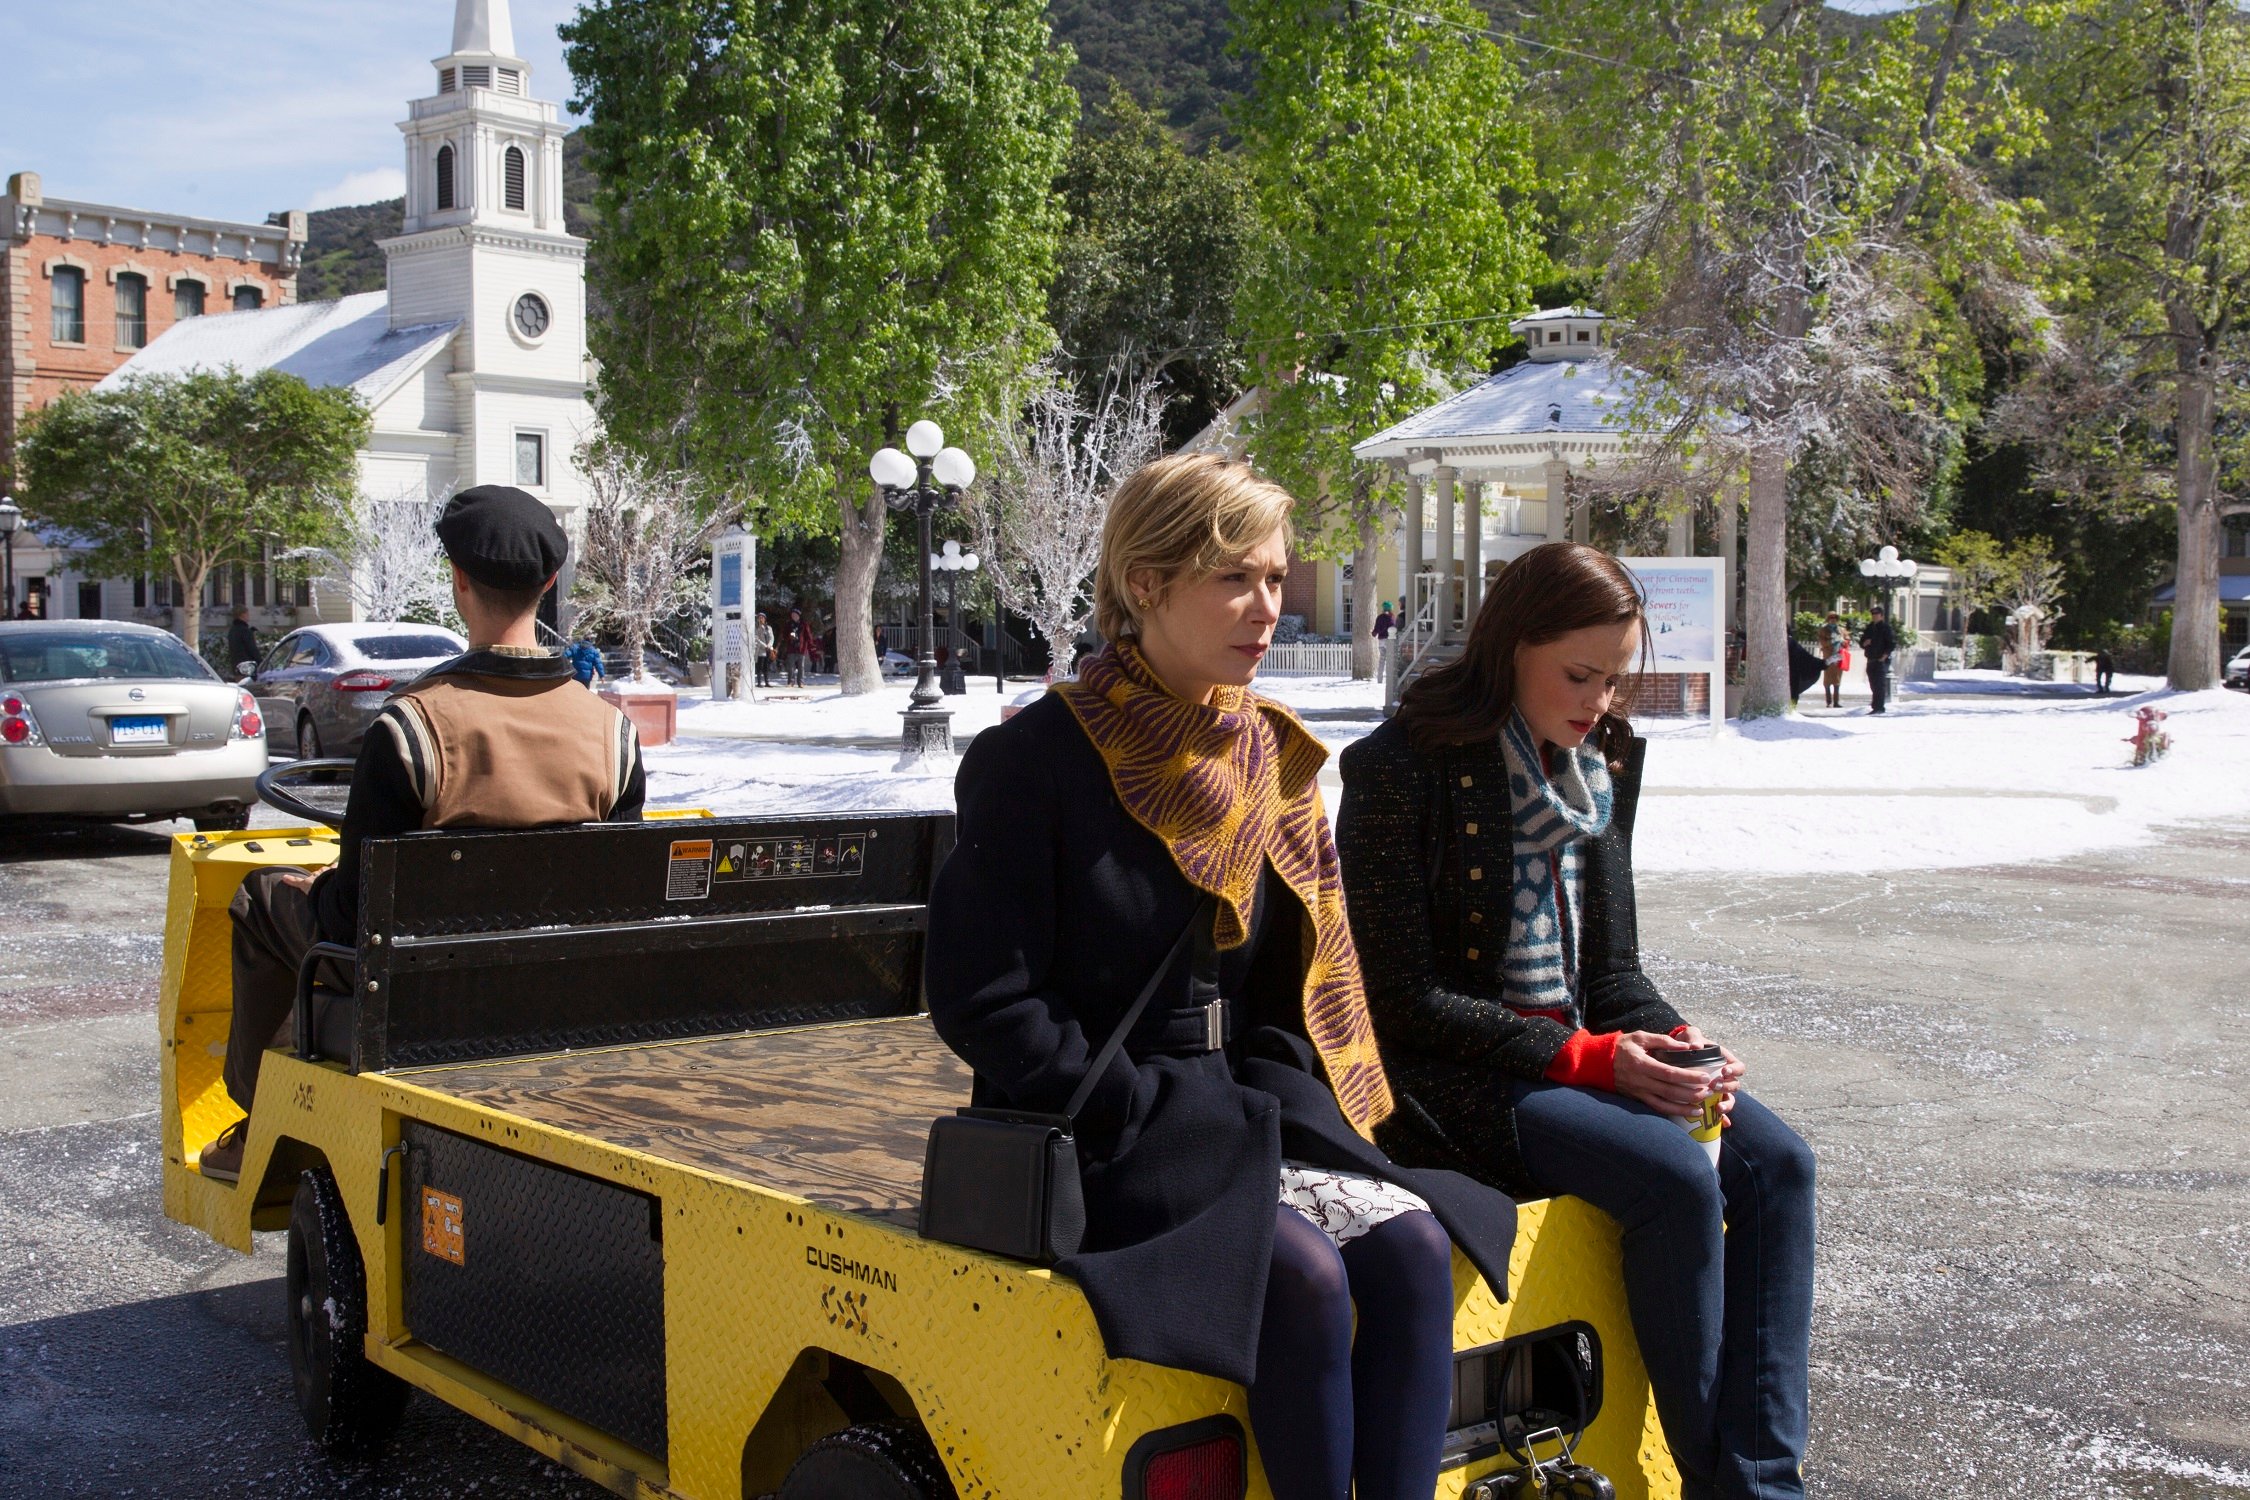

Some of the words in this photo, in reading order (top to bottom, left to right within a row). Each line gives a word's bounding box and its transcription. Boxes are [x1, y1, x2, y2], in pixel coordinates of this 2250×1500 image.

[1656, 575, 1666, 585] for
[1669, 574, 1708, 583] Christmas
[1655, 587, 1674, 596] front
[1648, 600, 1677, 610] Sewers
[1679, 600, 1690, 611] for
[806, 1245, 898, 1293] CUSHMAN
